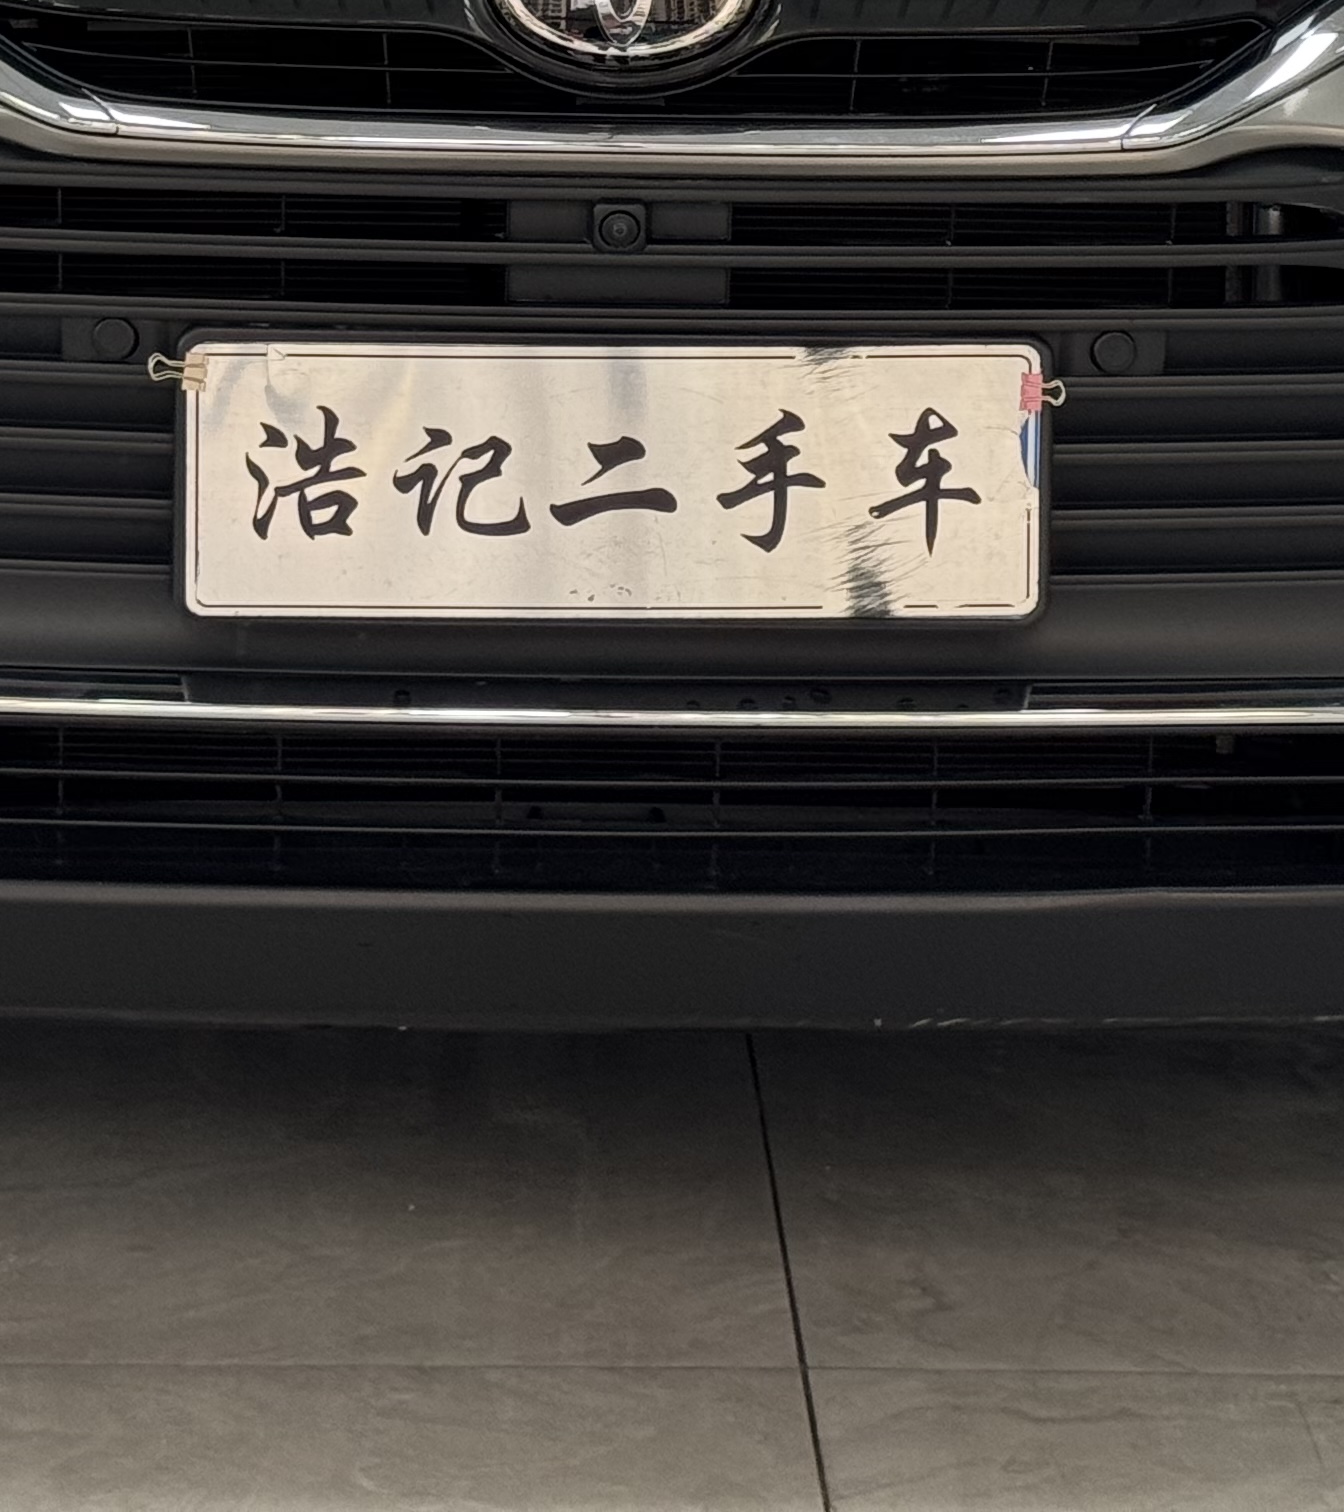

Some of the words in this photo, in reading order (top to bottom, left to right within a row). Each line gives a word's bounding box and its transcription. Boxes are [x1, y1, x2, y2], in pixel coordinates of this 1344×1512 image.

[245, 405, 982, 557] 浩记二手车
